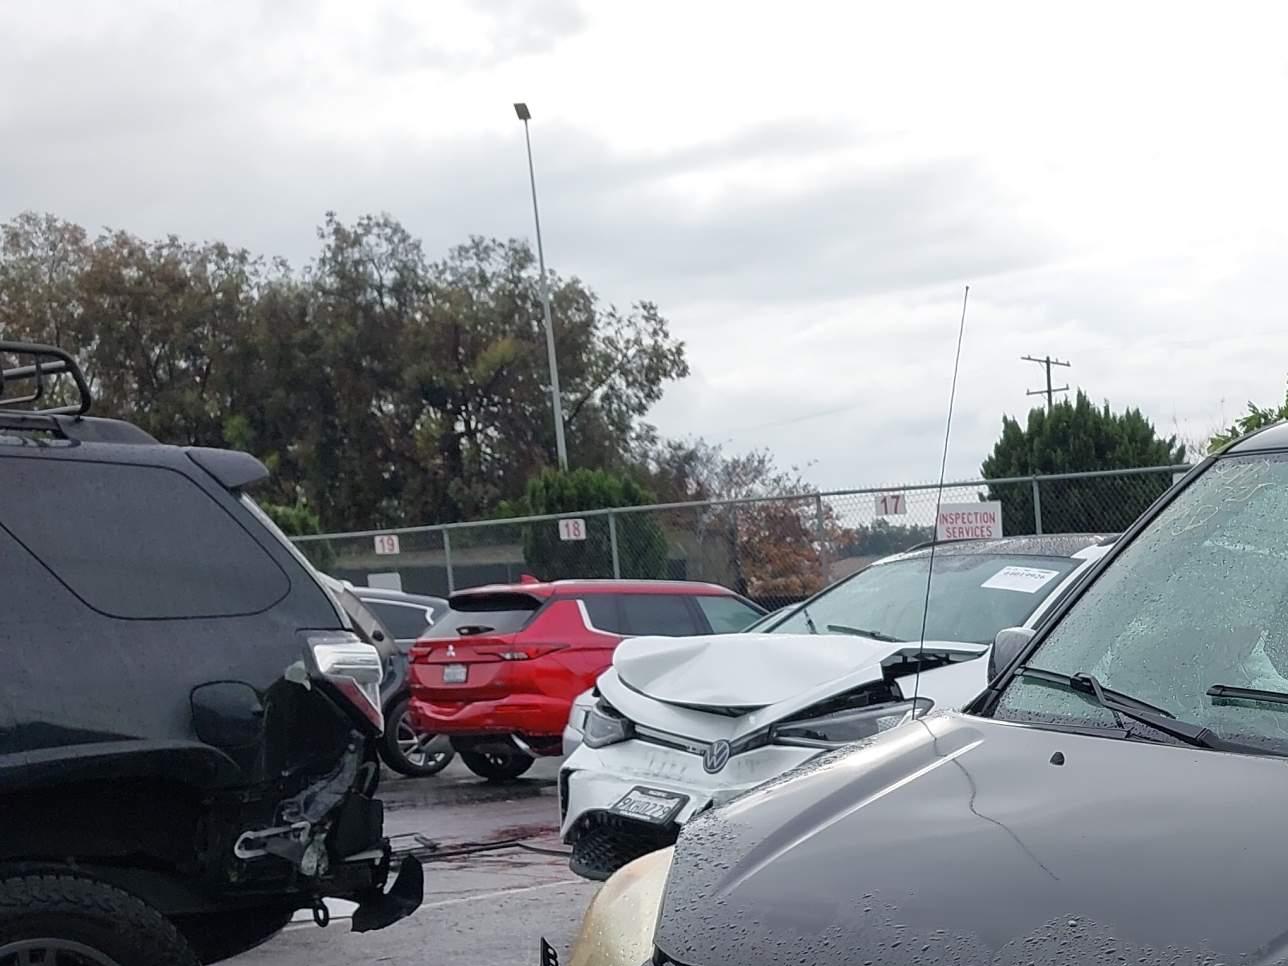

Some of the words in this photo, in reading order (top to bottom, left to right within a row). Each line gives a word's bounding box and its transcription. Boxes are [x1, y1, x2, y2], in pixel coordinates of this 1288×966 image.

[880, 495, 900, 514] 17
[939, 511, 996, 525] INSPECTION
[565, 522, 580, 537] 18
[945, 525, 993, 538] SERVICES
[379, 538, 394, 552] 19
